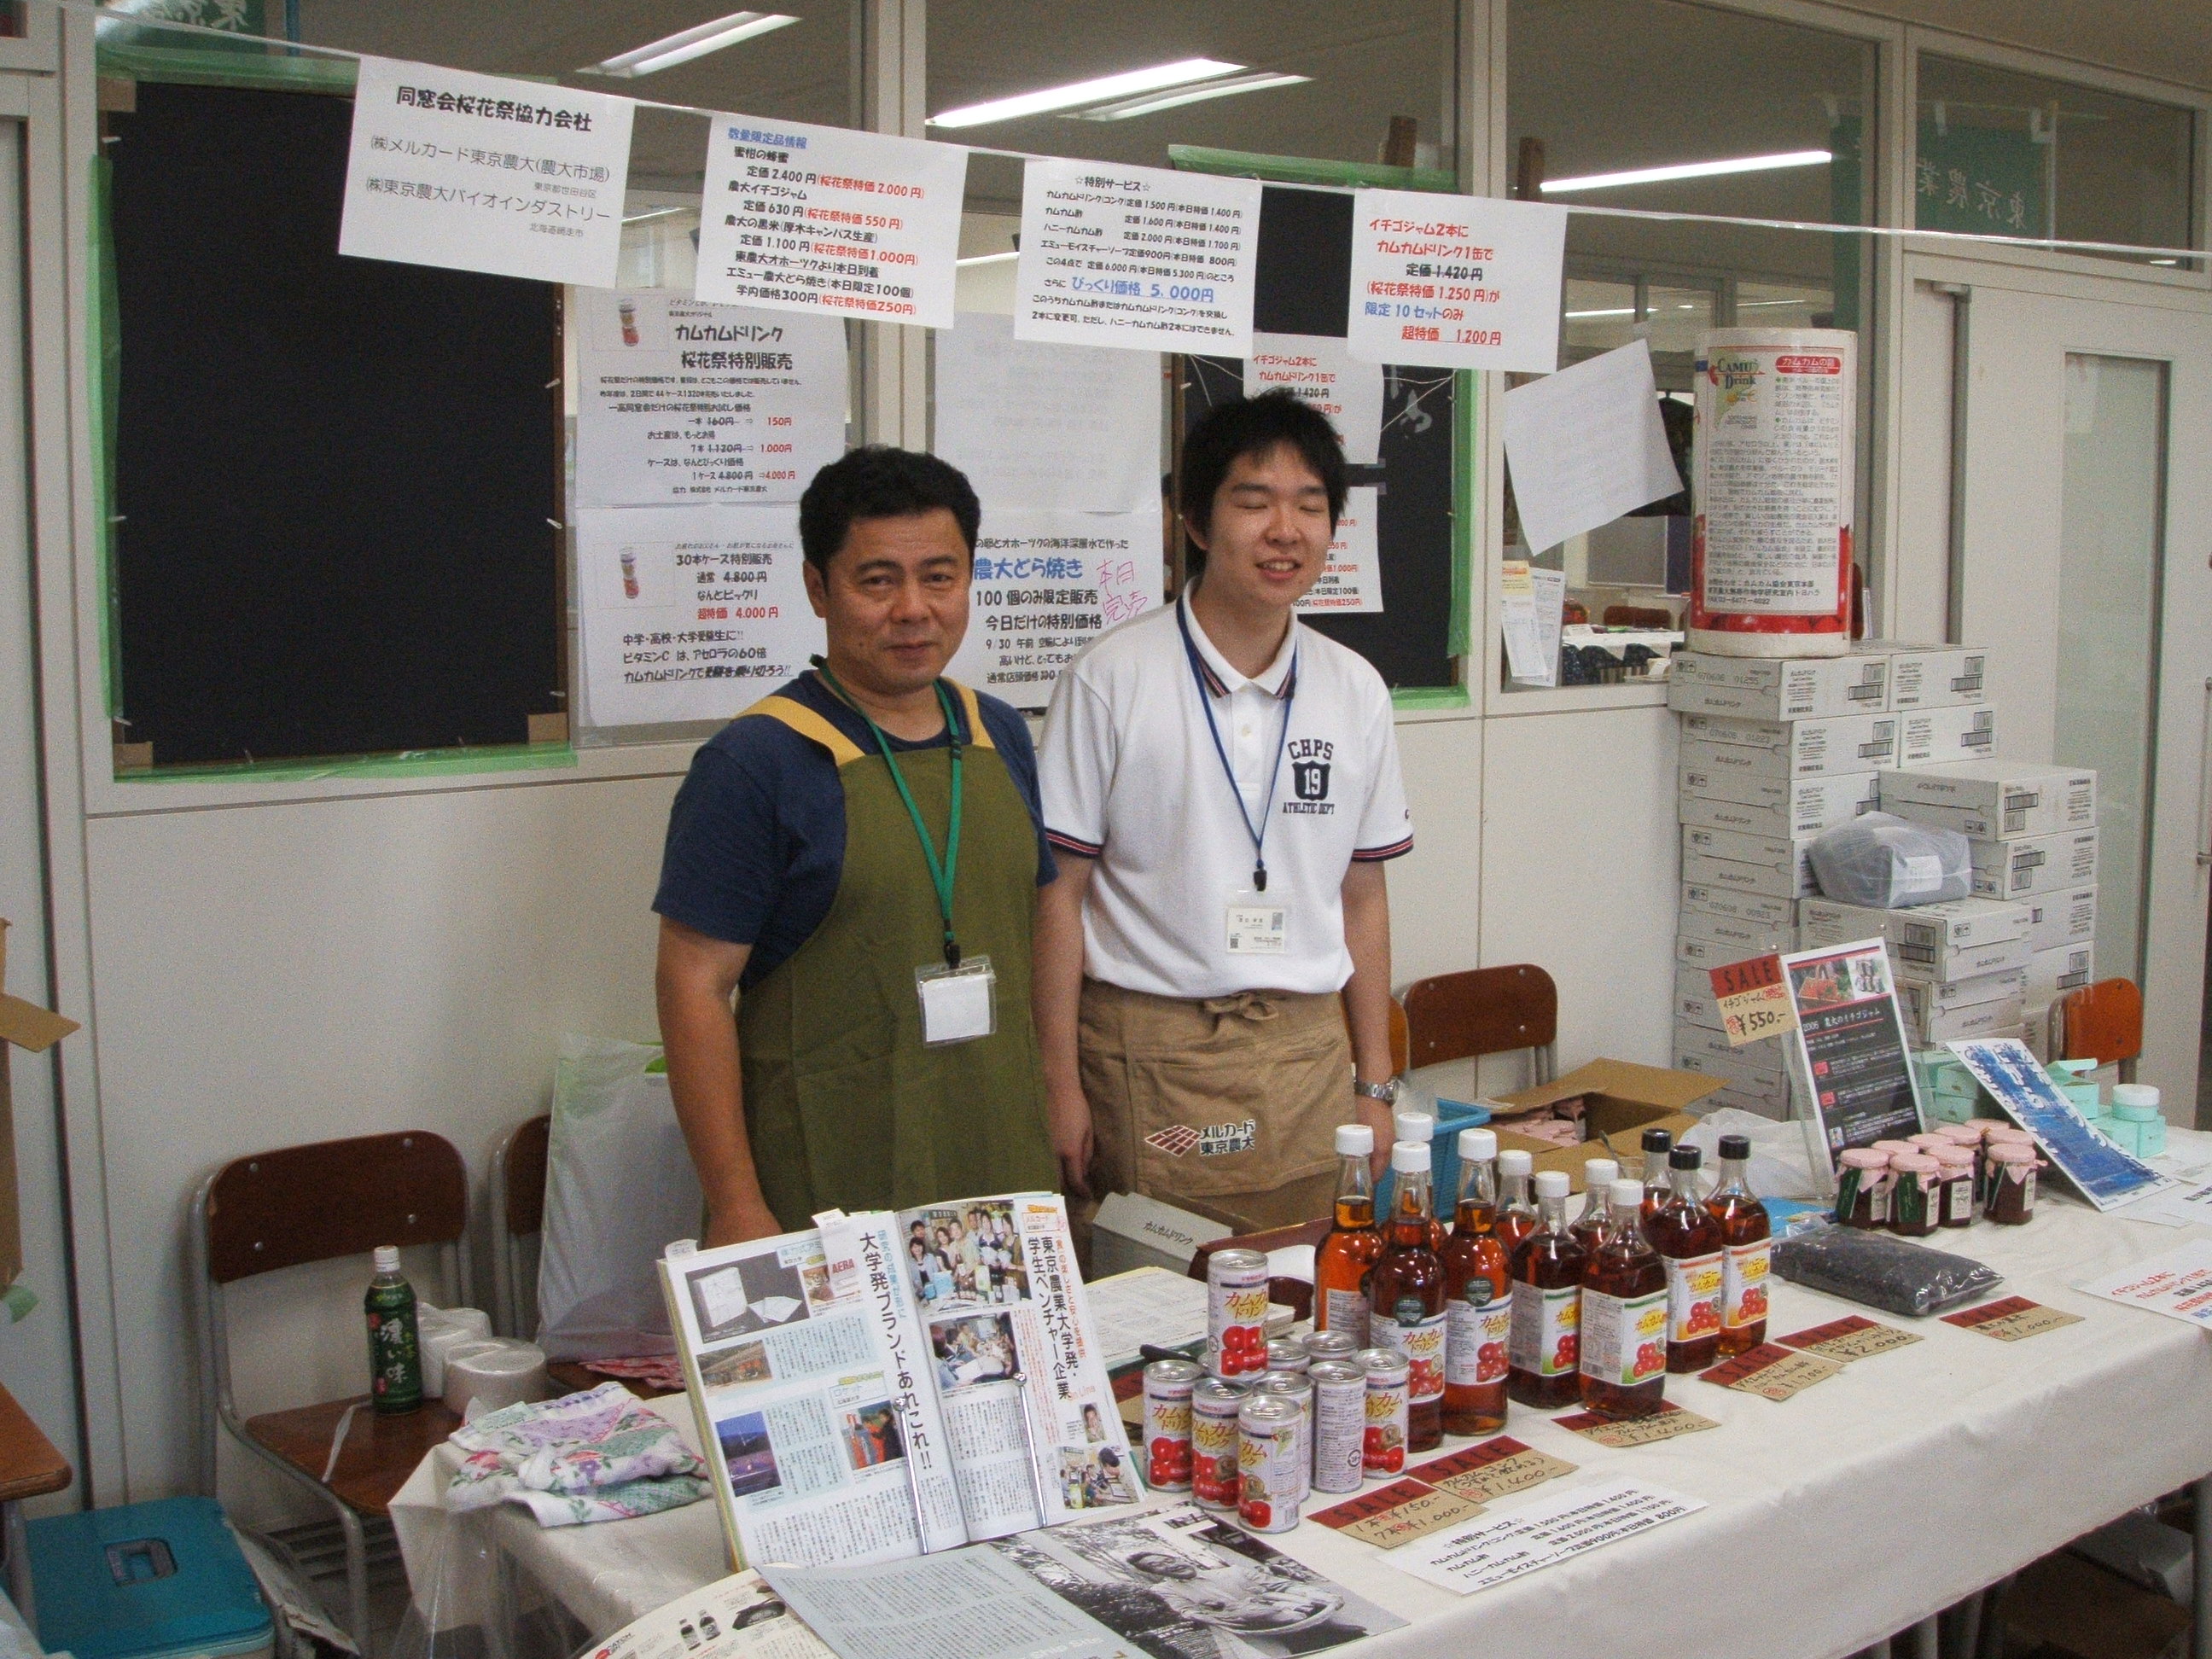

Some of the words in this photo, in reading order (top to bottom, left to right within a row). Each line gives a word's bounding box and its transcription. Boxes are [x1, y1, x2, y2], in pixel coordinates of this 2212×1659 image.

[396, 85, 591, 132] 同窓会桜花祭協力会社
[728, 127, 807, 148] 数量限定品情報
[747, 166, 769, 178] 定価
[728, 180, 807, 201] 農大イチゴジャム
[743, 200, 765, 212] 定価
[1370, 218, 1469, 238] イチゴジャム2本に
[740, 235, 763, 247] 定価
[1377, 240, 1493, 260] カムカムドリンク1缶で
[1072, 276, 1141, 297] びっくり価格
[1365, 302, 1390, 317] 限定
[1395, 304, 1409, 317] 10
[1414, 306, 1464, 321] セットのみ
[676, 324, 783, 342] カムカムドリンク
[1401, 326, 1440, 341] 超特価
[681, 352, 793, 370] 桜花祭特別販売
[1254, 356, 1317, 366] イチゴジャム2本に
[974, 557, 1083, 579] 農大どら焼き
[697, 589, 758, 601] なんとビックリ
[976, 591, 1002, 606] 100
[1007, 589, 1097, 606] 個のみ限定販売
[985, 614, 1103, 632] 今日だけの特別価格
[1305, 768, 1321, 795] 19
[1283, 802, 1317, 813] ATHLETIC
[1722, 960, 1773, 992] SALE
[1201, 1121, 1254, 1139] メルカード
[1200, 1136, 1254, 1155] 東京農大
[1144, 1221, 1193, 1245] カムカムドリンク
[1027, 1237, 1072, 1400] 学生ベンチャー企業
[1429, 1444, 1511, 1477] SALE
[1333, 1486, 1409, 1522] SALE
